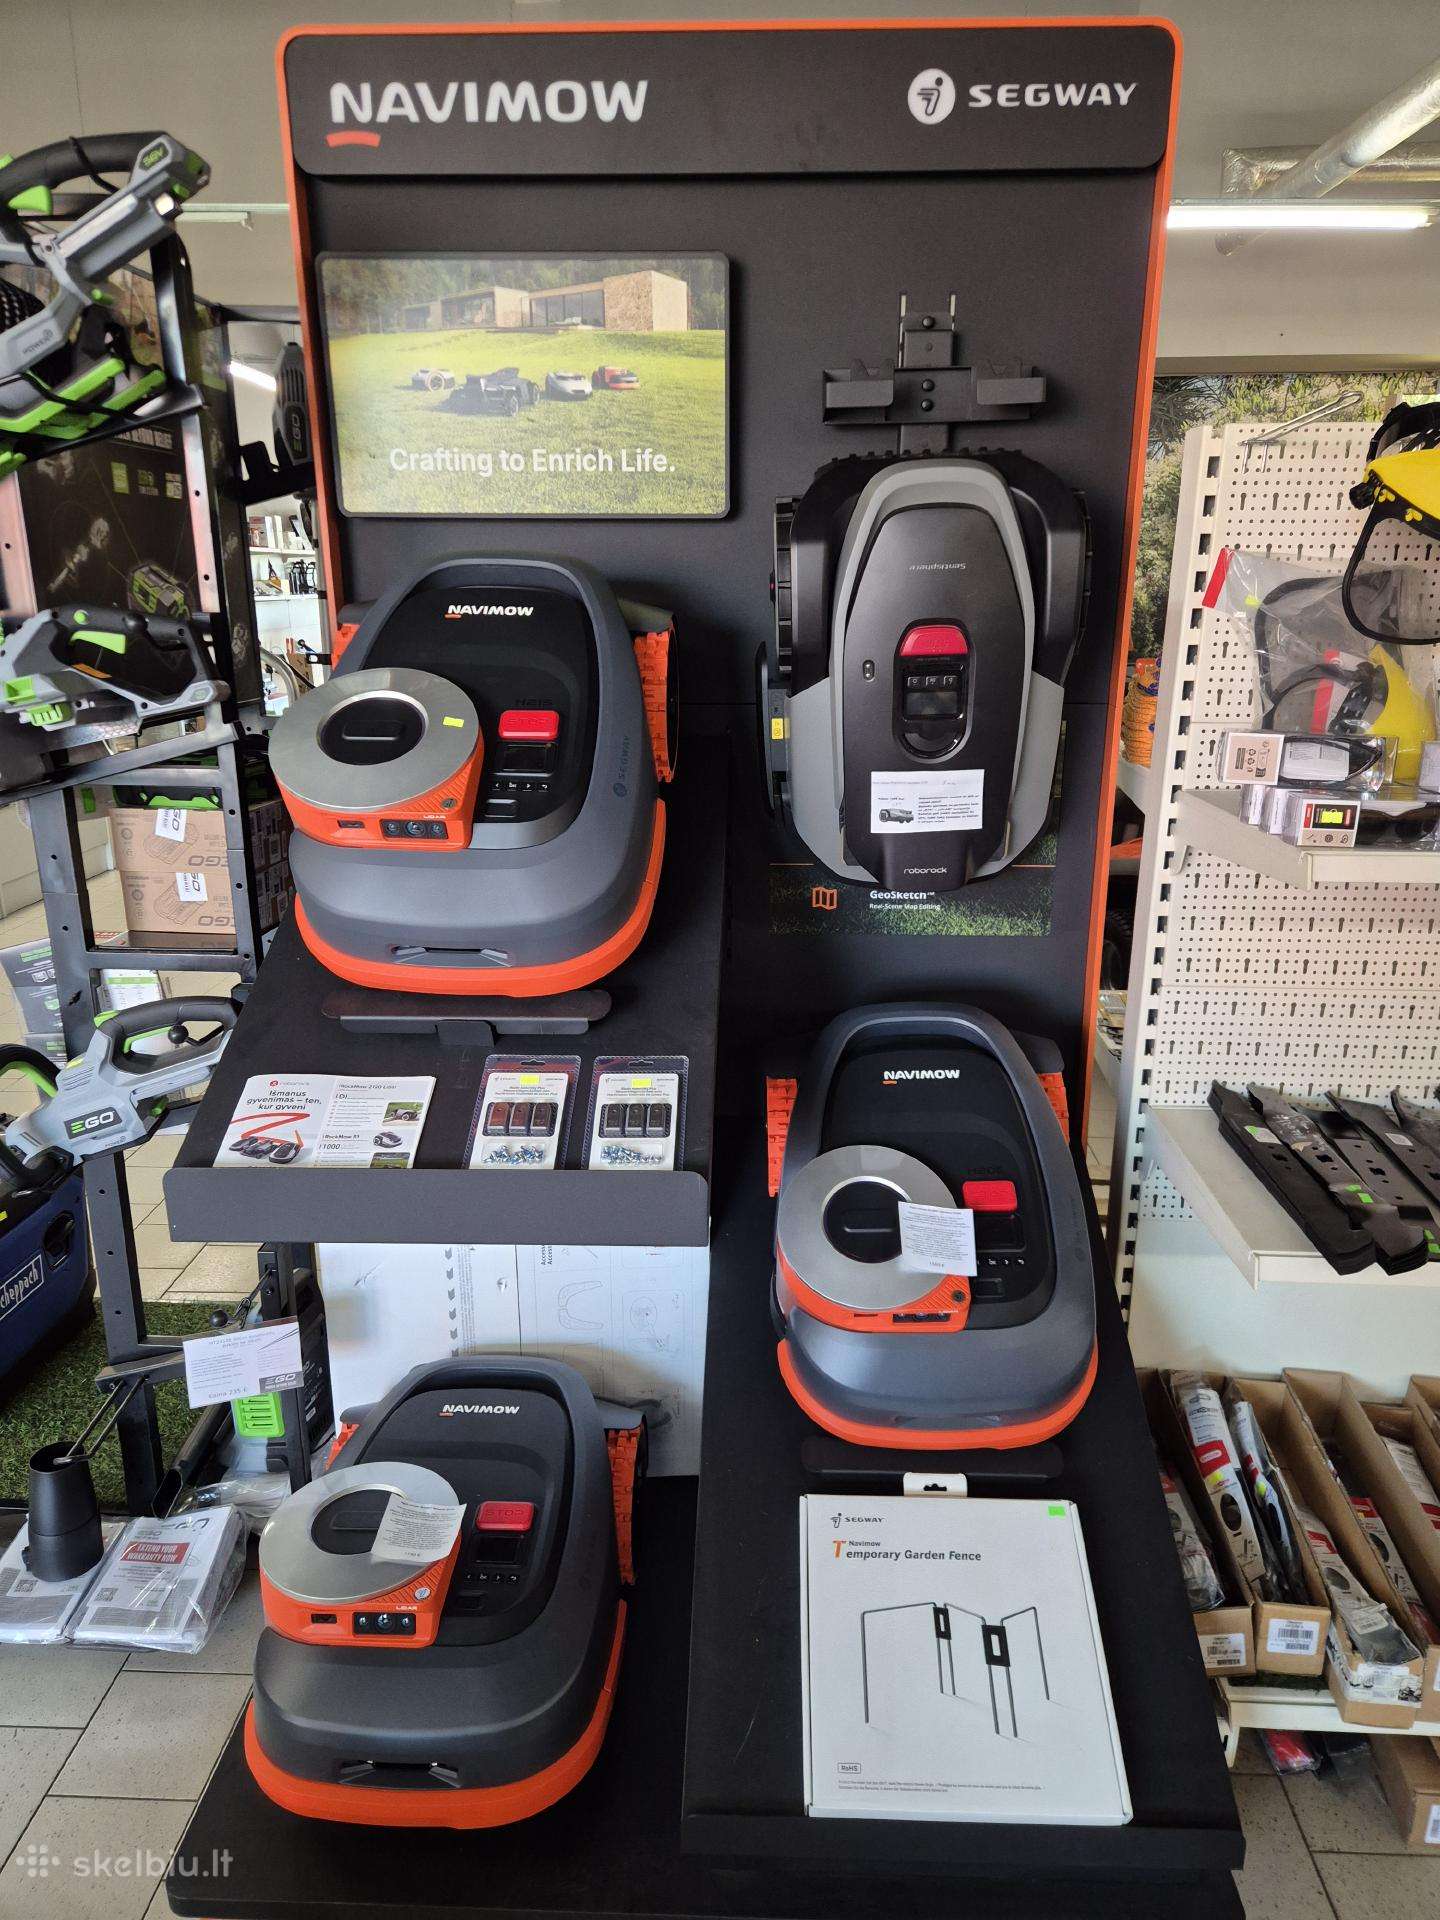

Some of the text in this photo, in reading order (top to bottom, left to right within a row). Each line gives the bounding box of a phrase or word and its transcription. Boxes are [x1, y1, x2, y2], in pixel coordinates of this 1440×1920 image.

[968, 83, 1137, 107] SEGWAY
[329, 81, 648, 123] NAVIMOW
[389, 448, 676, 477] Crafting to Enrich Life.
[448, 605, 534, 617] NAVIMOW
[905, 903, 918, 911] Map
[919, 903, 941, 911] Editing
[883, 1069, 961, 1080] NAVIMOW
[247, 1096, 294, 1105] gyvenimas
[305, 1097, 322, 1105] ten,
[275, 1103, 306, 1111] gyveni
[71, 1110, 114, 1134] EGO
[0, 1261, 39, 1308] cheppach
[442, 1404, 520, 1415] NAVIMOW
[137, 1543, 178, 1553] EXTEND YOUR
[126, 1552, 178, 1562] WARRANTY NOW
[904, 1550, 946, 1561] Garden
[949, 1551, 982, 1562] Fence
